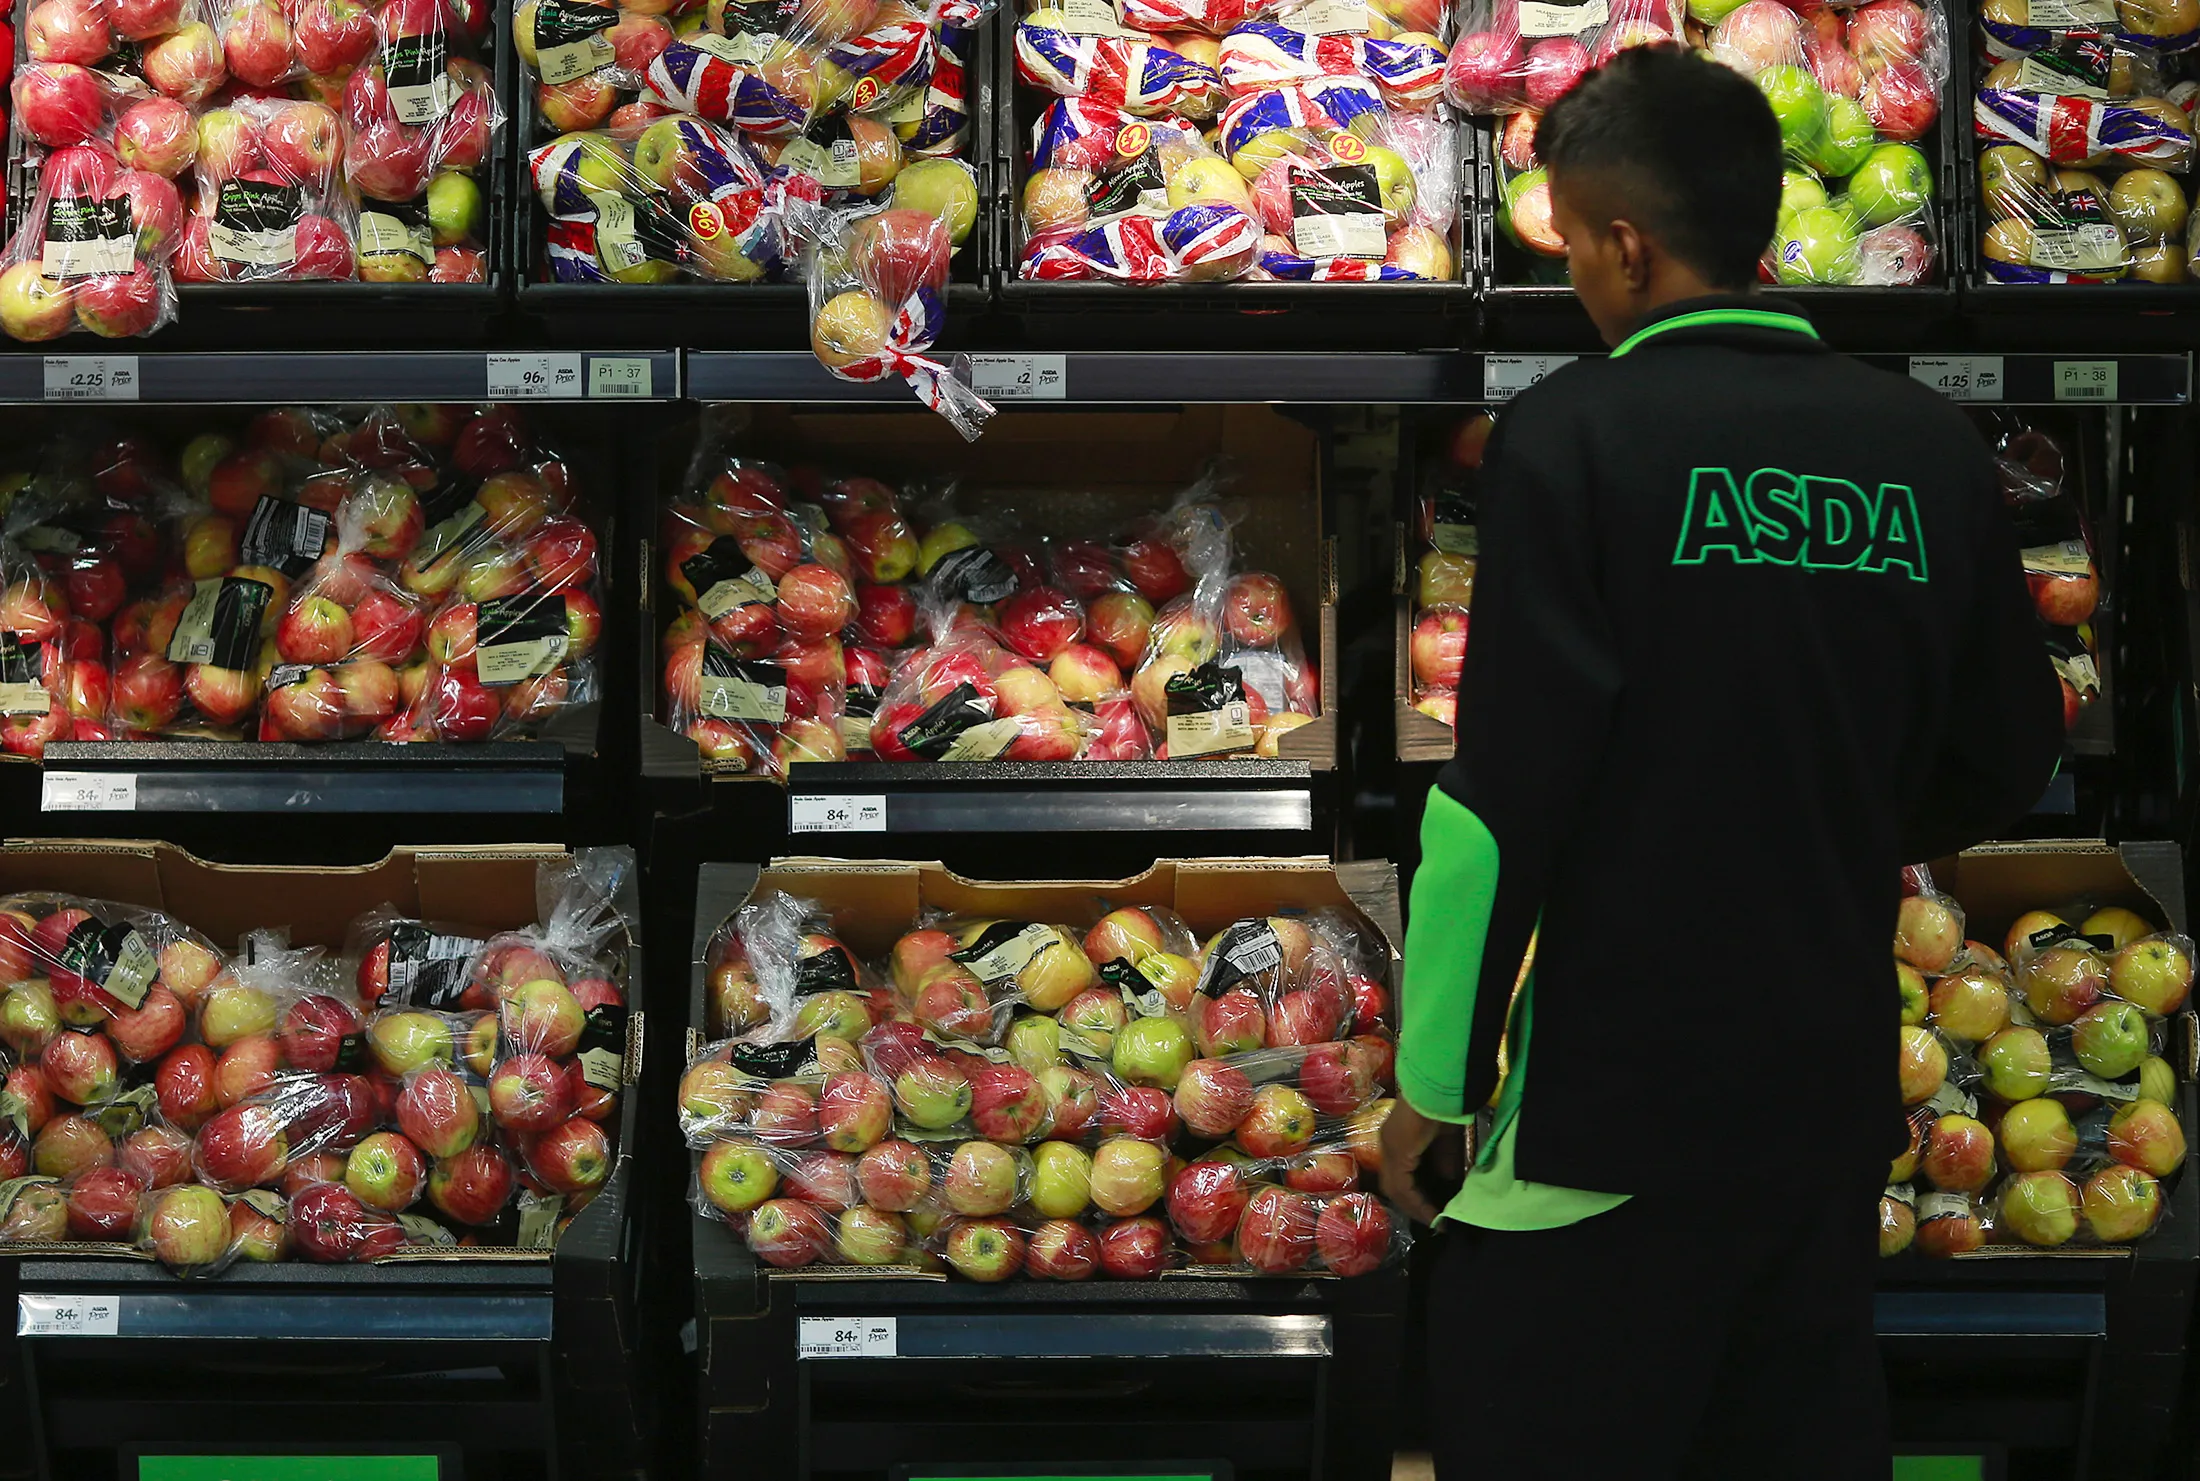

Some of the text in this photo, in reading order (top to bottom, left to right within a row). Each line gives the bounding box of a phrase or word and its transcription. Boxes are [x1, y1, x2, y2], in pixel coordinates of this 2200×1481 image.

[1120, 126, 1144, 150] £2
[1335, 138, 1362, 158] £2
[1340, 180, 1364, 191] Apples
[243, 190, 260, 199] Pink
[694, 207, 716, 234] 96p
[523, 371, 545, 384] 96p
[555, 374, 575, 384] Price
[599, 368, 613, 377] P1
[627, 368, 641, 378] 37
[1017, 372, 1031, 384] £2
[2065, 371, 2078, 380] P1
[2092, 371, 2106, 381] 38
[70, 374, 103, 386] £2.25
[111, 377, 132, 386] Price
[1039, 376, 1059, 385] Price
[1938, 375, 1969, 388] £1.25
[1977, 378, 1998, 388] Price
[1672, 467, 1928, 583] ASDA
[903, 725, 920, 741] ASDA
[924, 718, 946, 738] Apples
[76, 789, 98, 801] 84p
[827, 809, 849, 821] 84p
[860, 812, 879, 820] Price
[2036, 931, 2054, 942] ASDA
[55, 1308, 78, 1320] 84p
[88, 1312, 109, 1321] Price
[835, 1330, 858, 1342] 84p
[868, 1333, 889, 1342] Price
